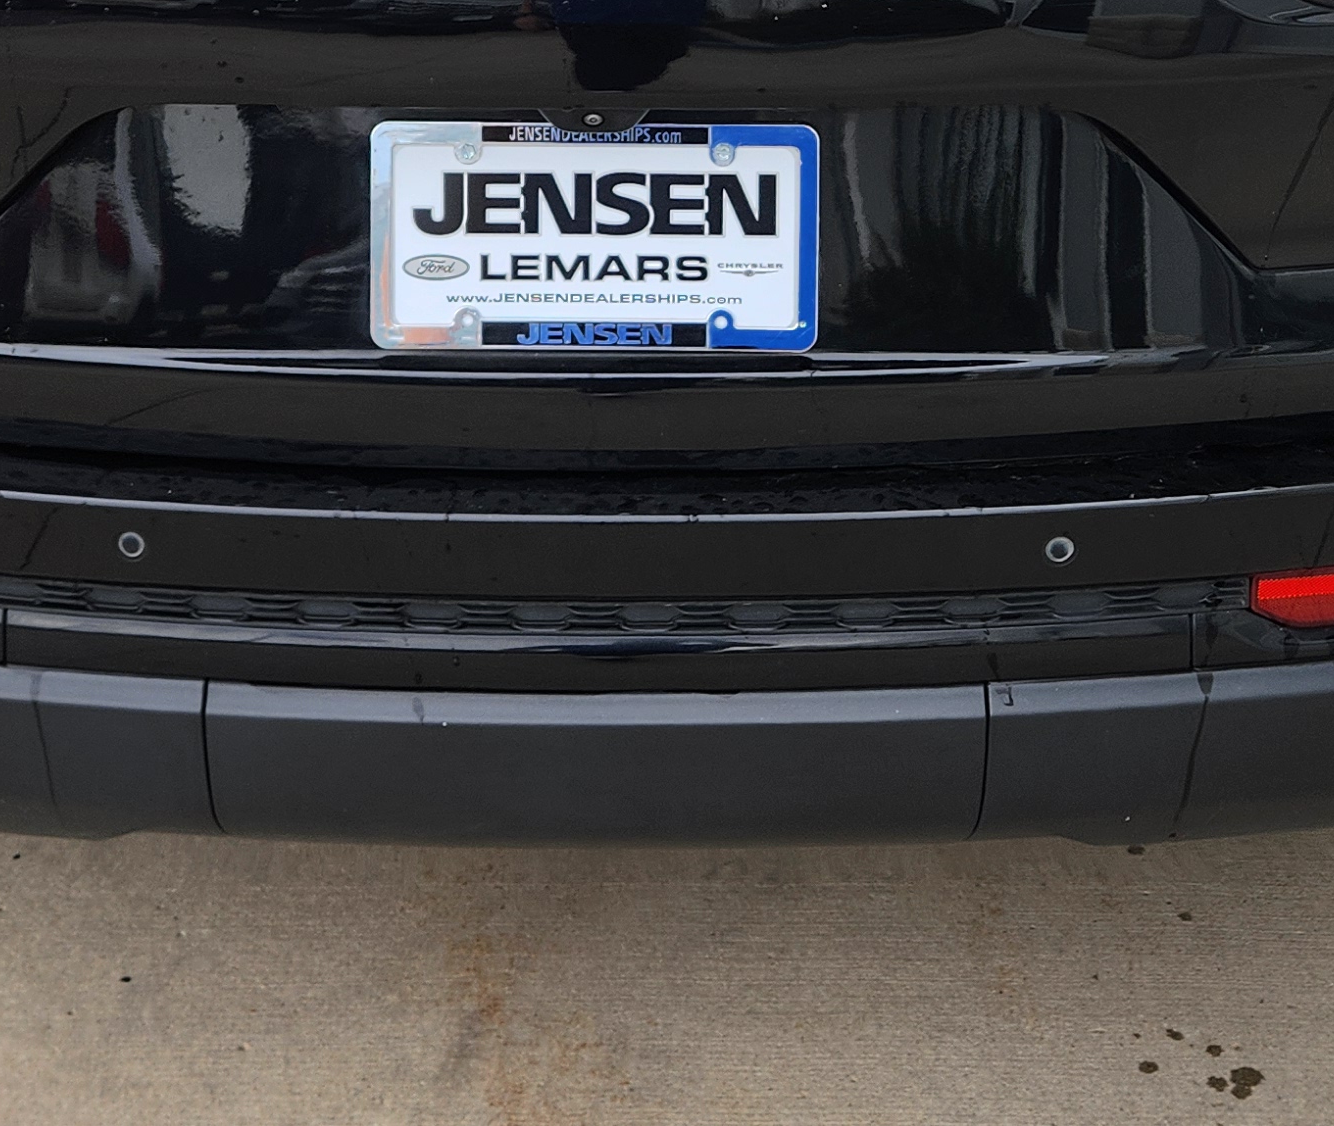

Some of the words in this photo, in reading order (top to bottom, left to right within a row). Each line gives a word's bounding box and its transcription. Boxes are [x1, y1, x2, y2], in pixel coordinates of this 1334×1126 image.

[412, 172, 778, 236] JENSEN
[479, 254, 708, 281] LEMARS
[446, 292, 743, 305] www.JENSENDEALERSHIPS.com
[516, 322, 673, 345] JENSEN
